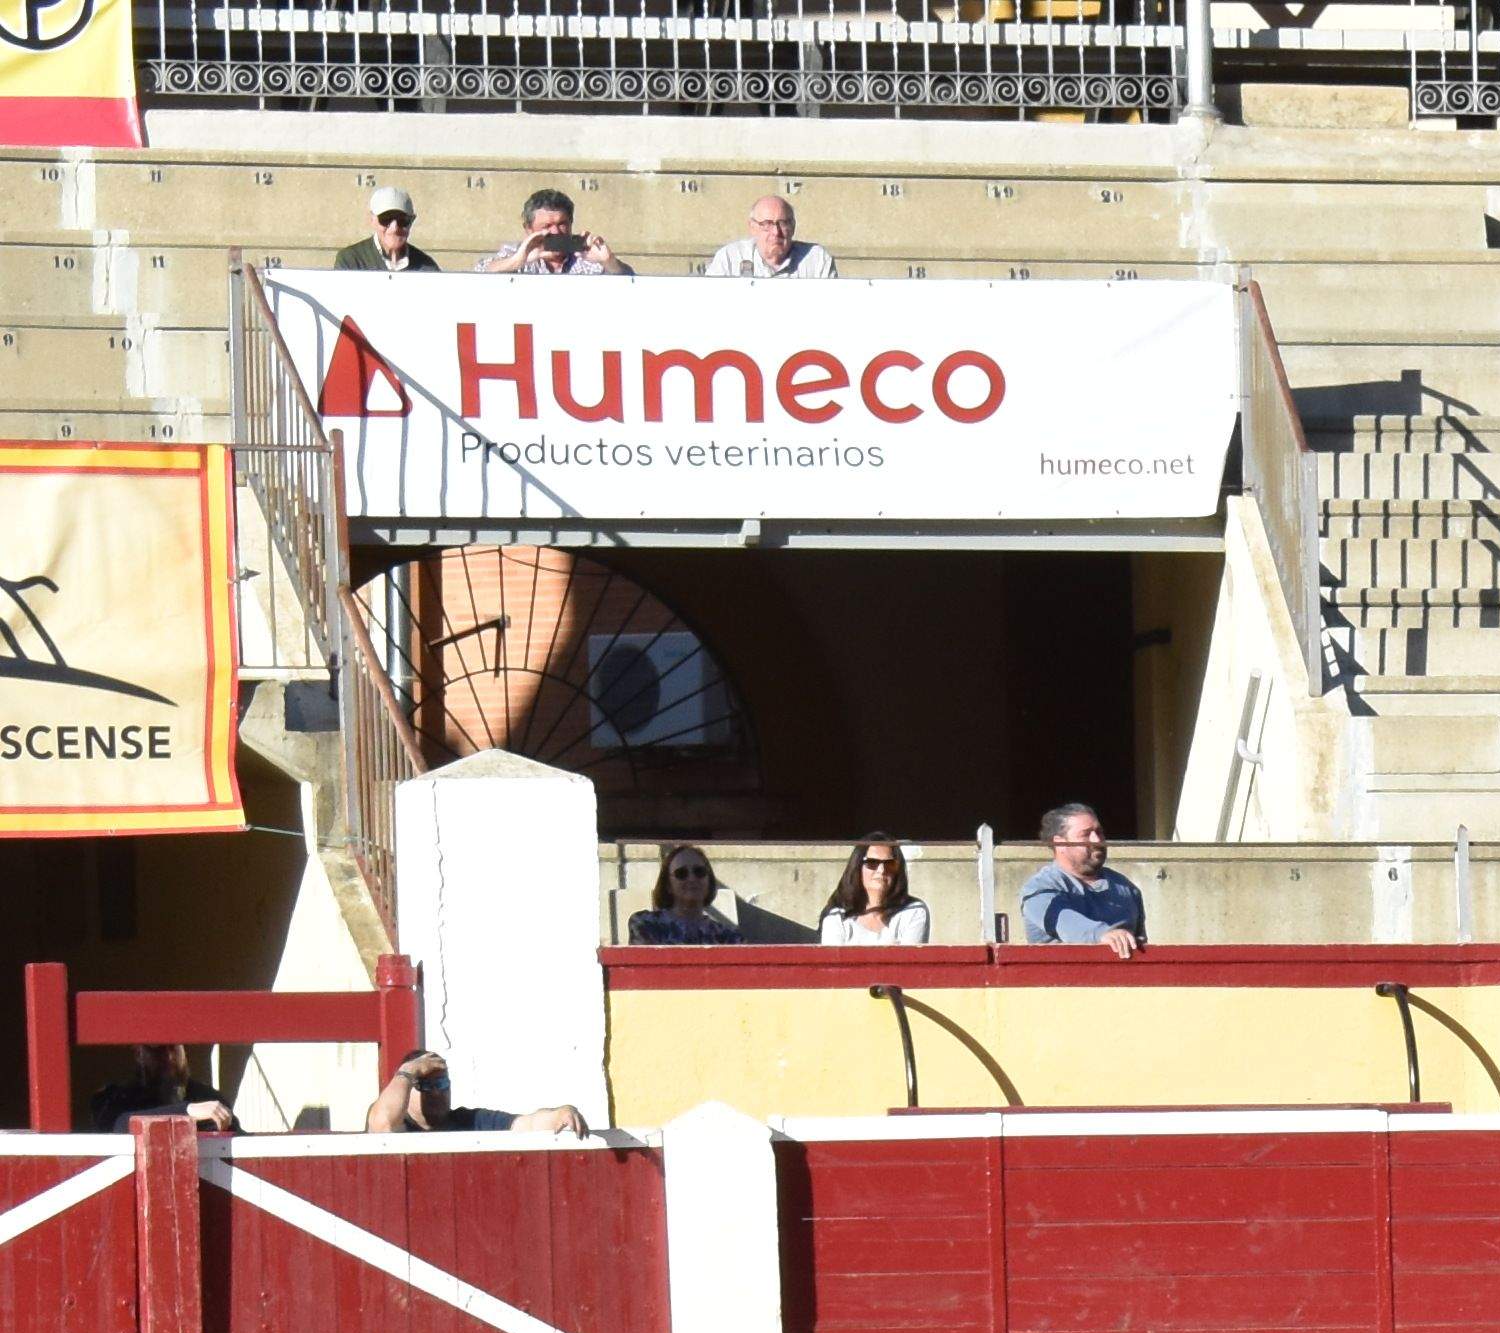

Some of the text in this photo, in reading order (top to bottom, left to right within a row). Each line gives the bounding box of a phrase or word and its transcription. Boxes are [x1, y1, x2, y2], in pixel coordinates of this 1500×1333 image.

[42, 168, 58, 180] 10
[151, 170, 161, 183] 11
[256, 172, 273, 185] 12
[467, 176, 485, 189] 14
[681, 180, 697, 193] 16
[883, 184, 899, 196] 18
[1101, 191, 1123, 203] 20
[55, 256, 74, 269] 10
[152, 256, 164, 268] 11
[908, 266, 926, 279] 18
[109, 337, 132, 350] 10
[457, 322, 1006, 424] Humeco
[61, 426, 71, 437] 9
[151, 425, 173, 437] 10
[460, 432, 885, 468] Productos veterinarios
[1040, 452, 1196, 476] humeco.net
[0, 725, 172, 760] SCENSE
[1157, 867, 1167, 881] 4
[1388, 868, 1398, 881] 6
